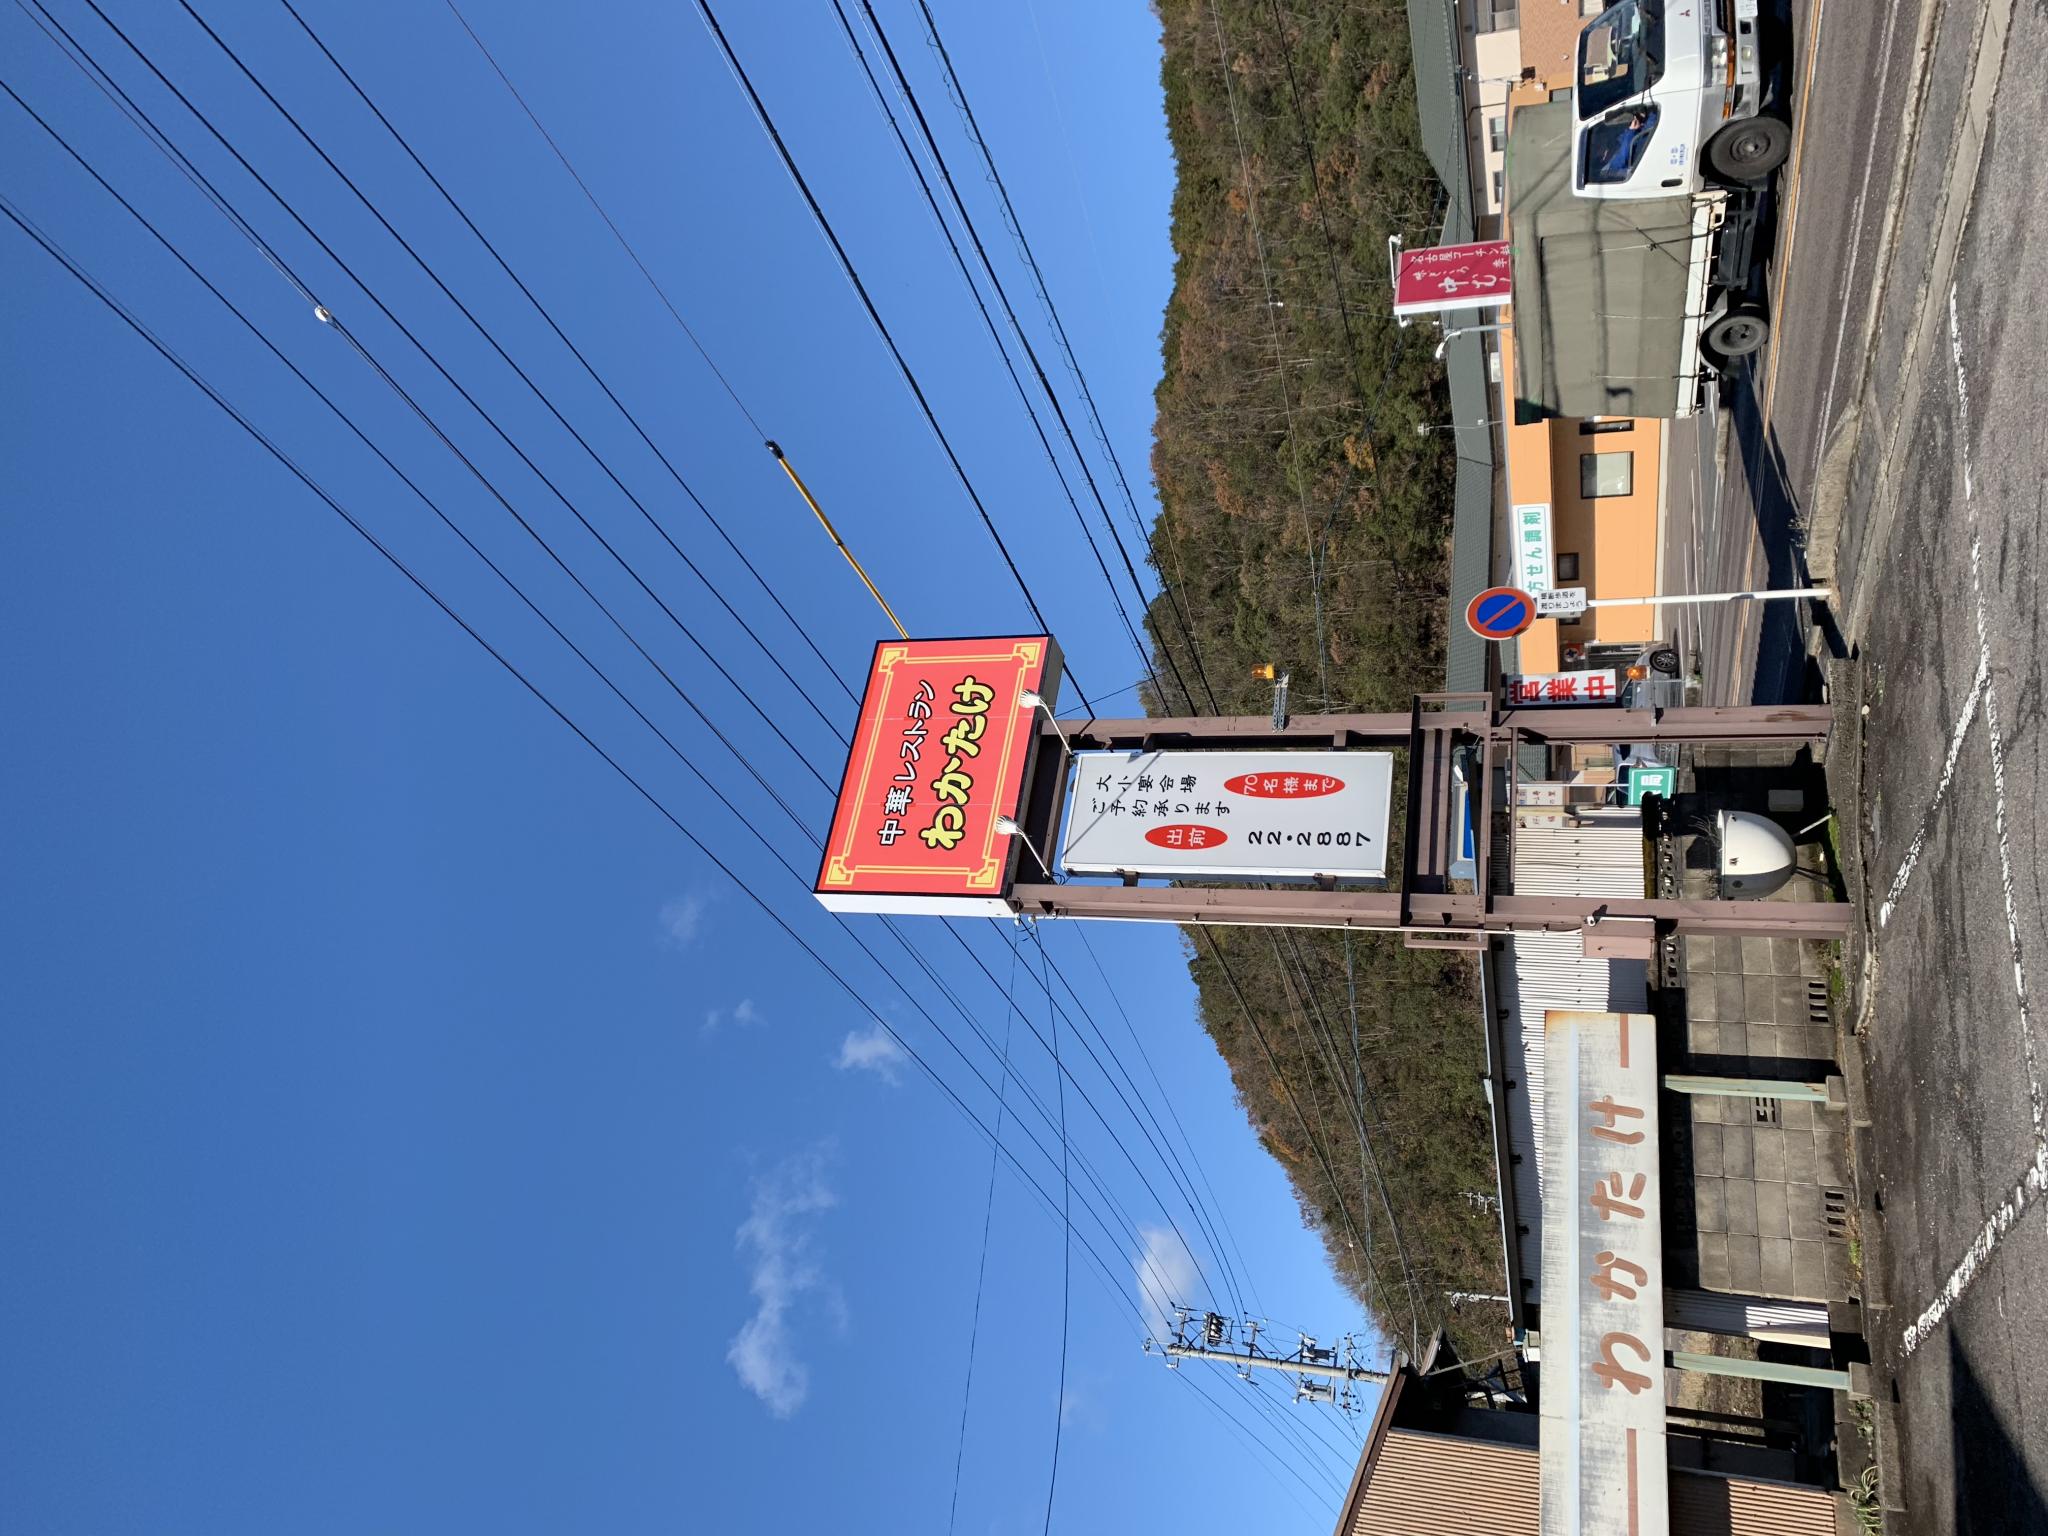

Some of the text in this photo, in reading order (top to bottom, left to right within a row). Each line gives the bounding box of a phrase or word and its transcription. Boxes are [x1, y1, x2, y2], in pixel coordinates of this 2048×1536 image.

[1522, 511, 1544, 593] 方せん調剤
[1540, 590, 1577, 600] 横断歩道を
[1541, 600, 1583, 610] 渡りましょう
[1509, 674, 1616, 705] 営業中
[877, 680, 934, 846] 中華レストラン
[919, 676, 994, 849] わかたけ
[1095, 774, 1197, 793] 大小宴会場
[1243, 774, 1336, 795] 70名様まで
[1091, 798, 1230, 817] ご予約承ります
[1166, 827, 1207, 846] 出前
[1589, 1095, 1653, 1395] わかたけ
